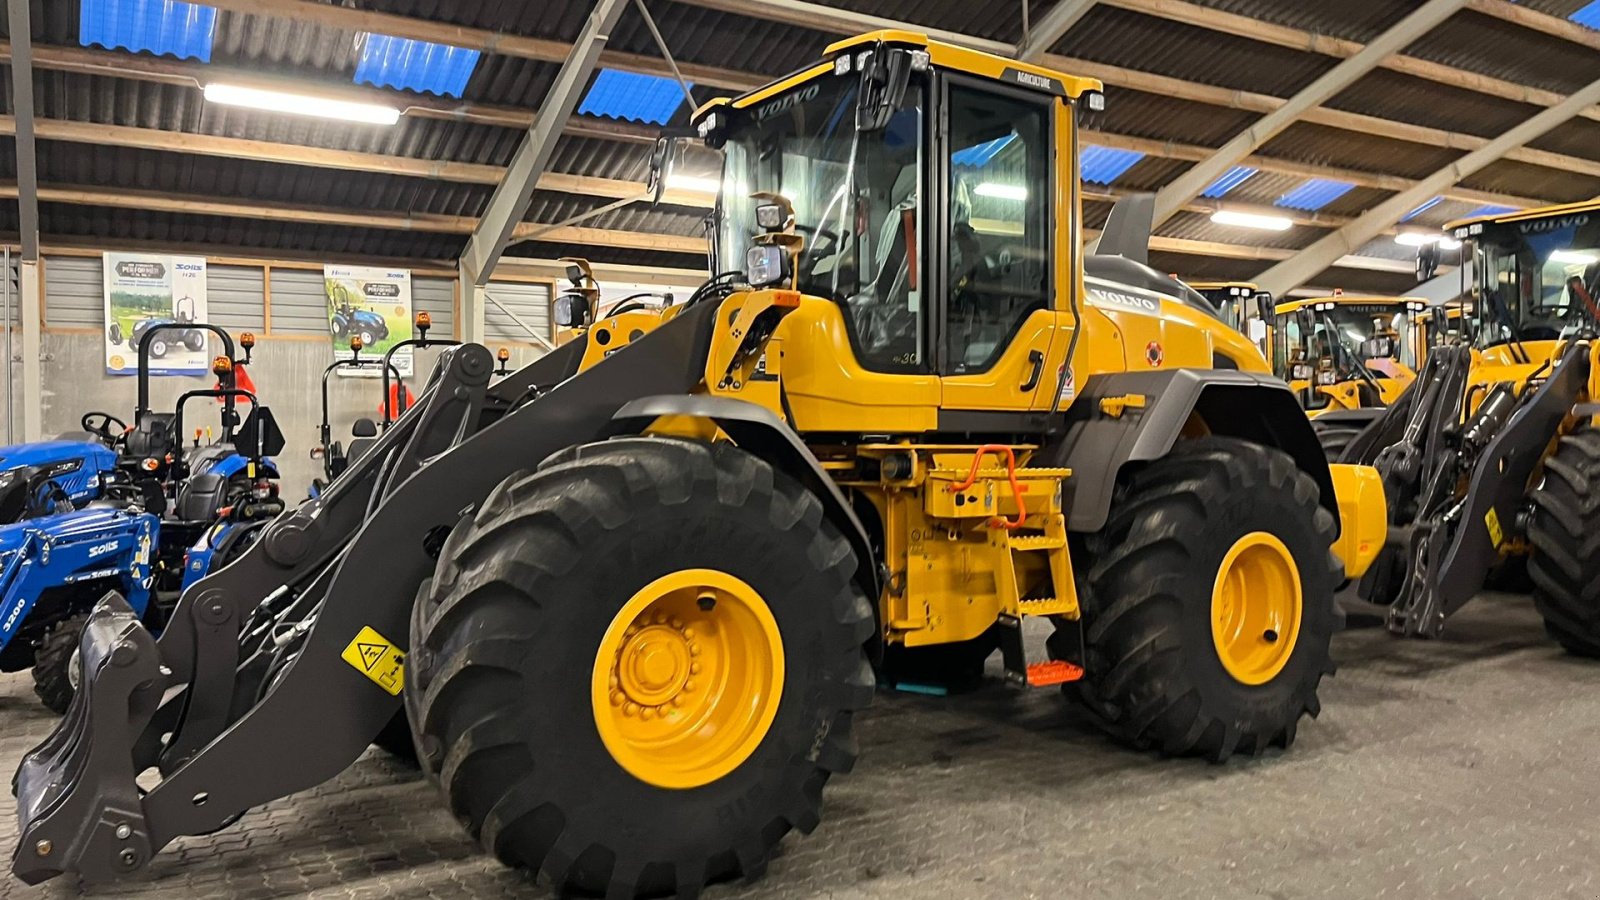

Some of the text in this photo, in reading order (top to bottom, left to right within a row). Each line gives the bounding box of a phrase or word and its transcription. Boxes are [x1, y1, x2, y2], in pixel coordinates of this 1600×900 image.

[1017, 71, 1051, 90] AGRICULTURE
[758, 84, 820, 119] VOLVO
[1520, 215, 1589, 233] VOLVO
[1090, 288, 1156, 311] VOLVO
[3, 598, 26, 632] 3200
